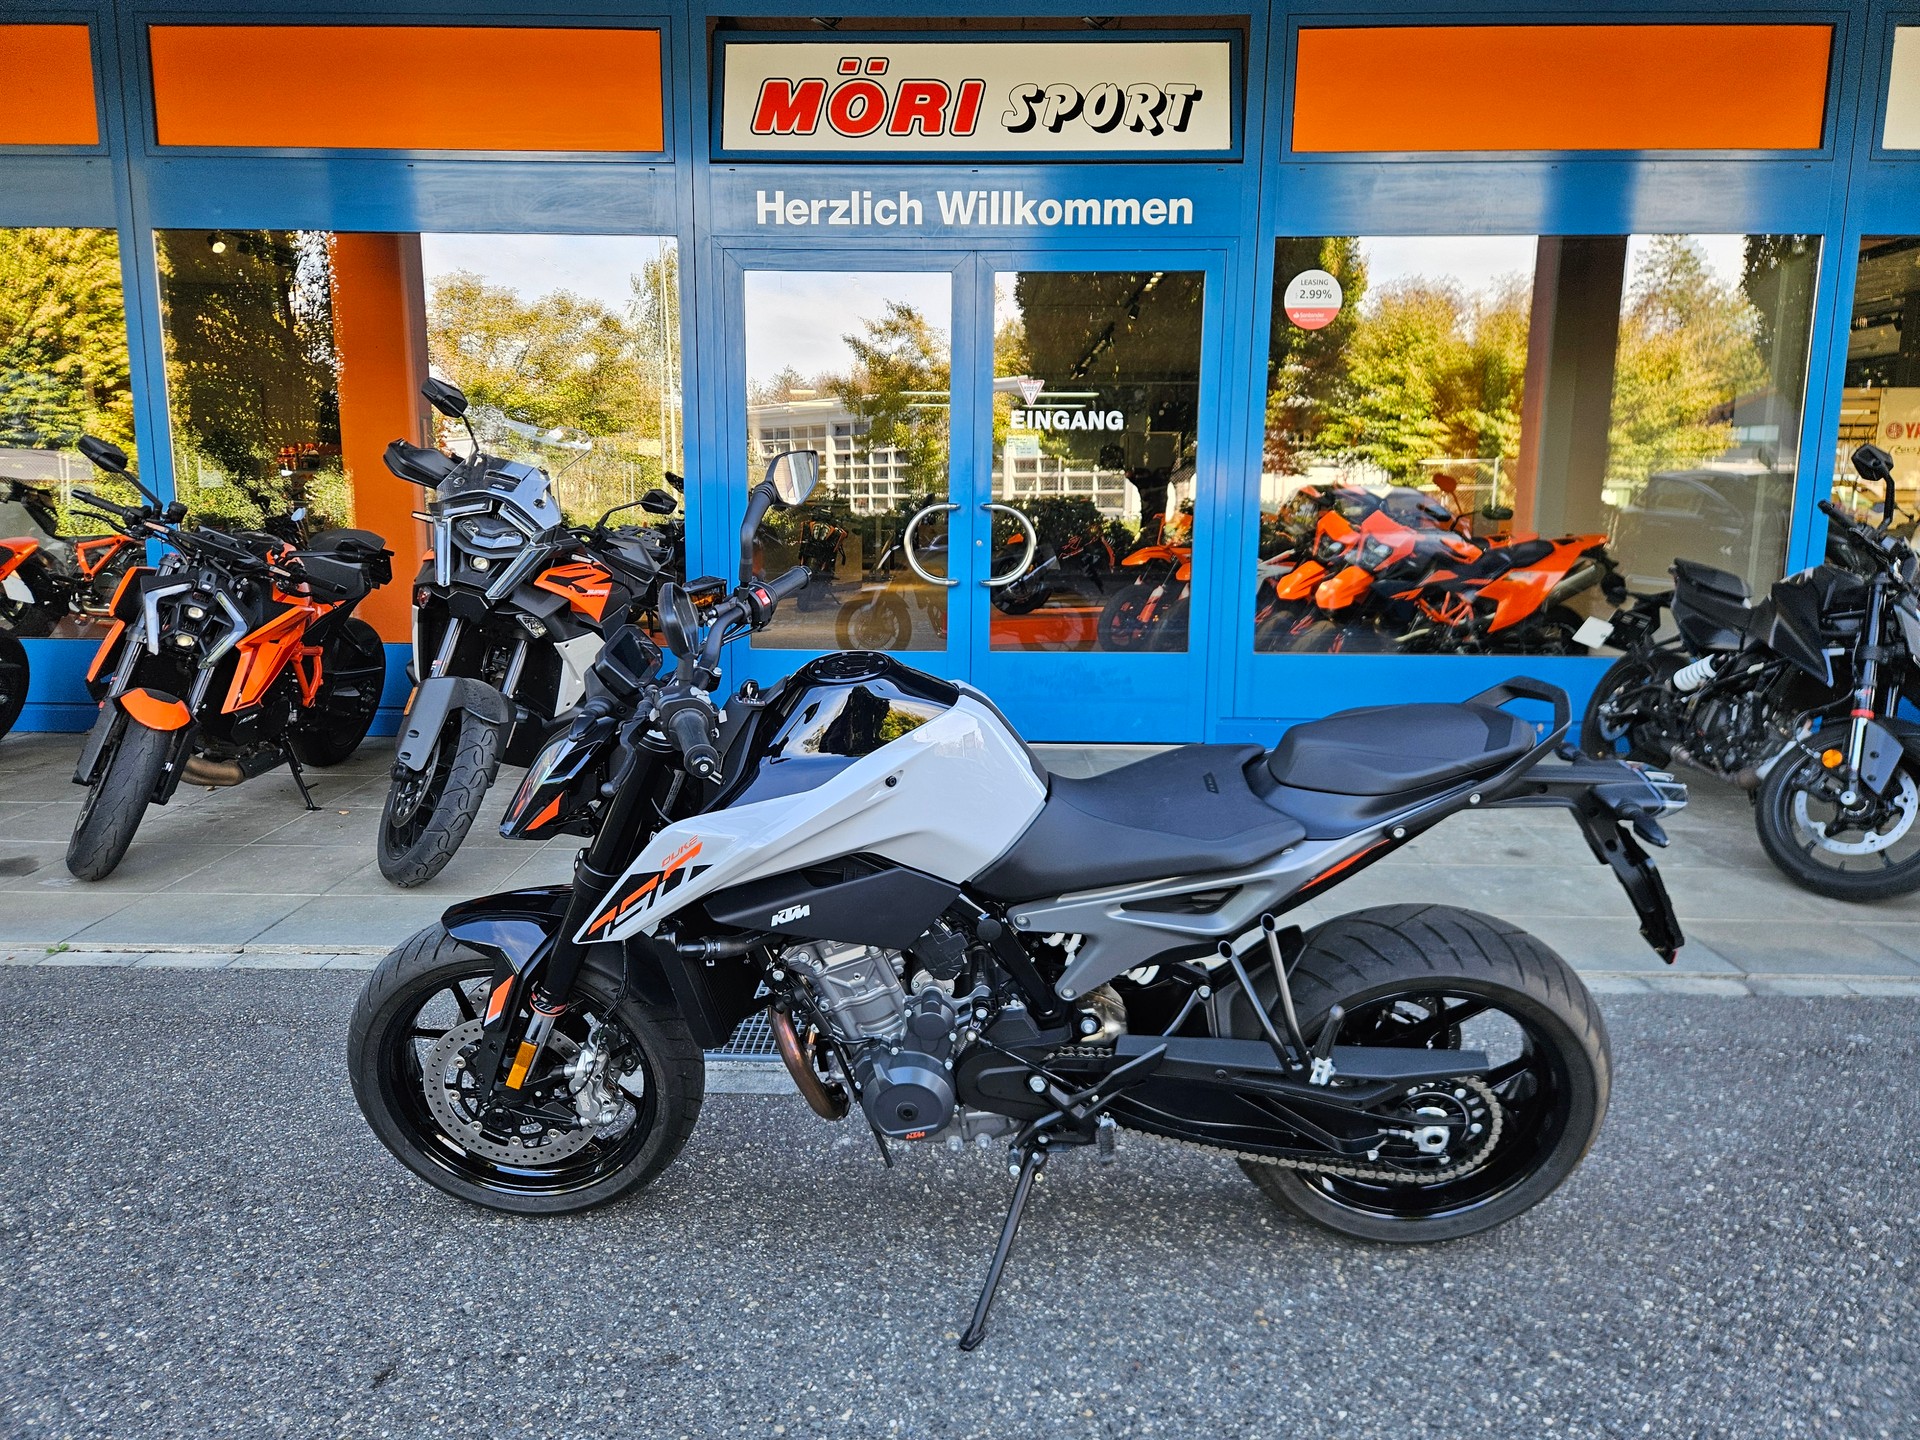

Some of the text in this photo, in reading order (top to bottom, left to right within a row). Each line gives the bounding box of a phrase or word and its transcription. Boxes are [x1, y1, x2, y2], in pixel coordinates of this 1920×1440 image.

[750, 56, 1203, 138] MÖRI SPORT
[756, 190, 1193, 226] Herzlich Willkommen
[1300, 289, 1332, 299] 2.99%
[1010, 410, 1124, 431] EINGANG
[661, 835, 699, 868] DUKE
[770, 904, 810, 927] KTM
[905, 1130, 925, 1140] KTM
